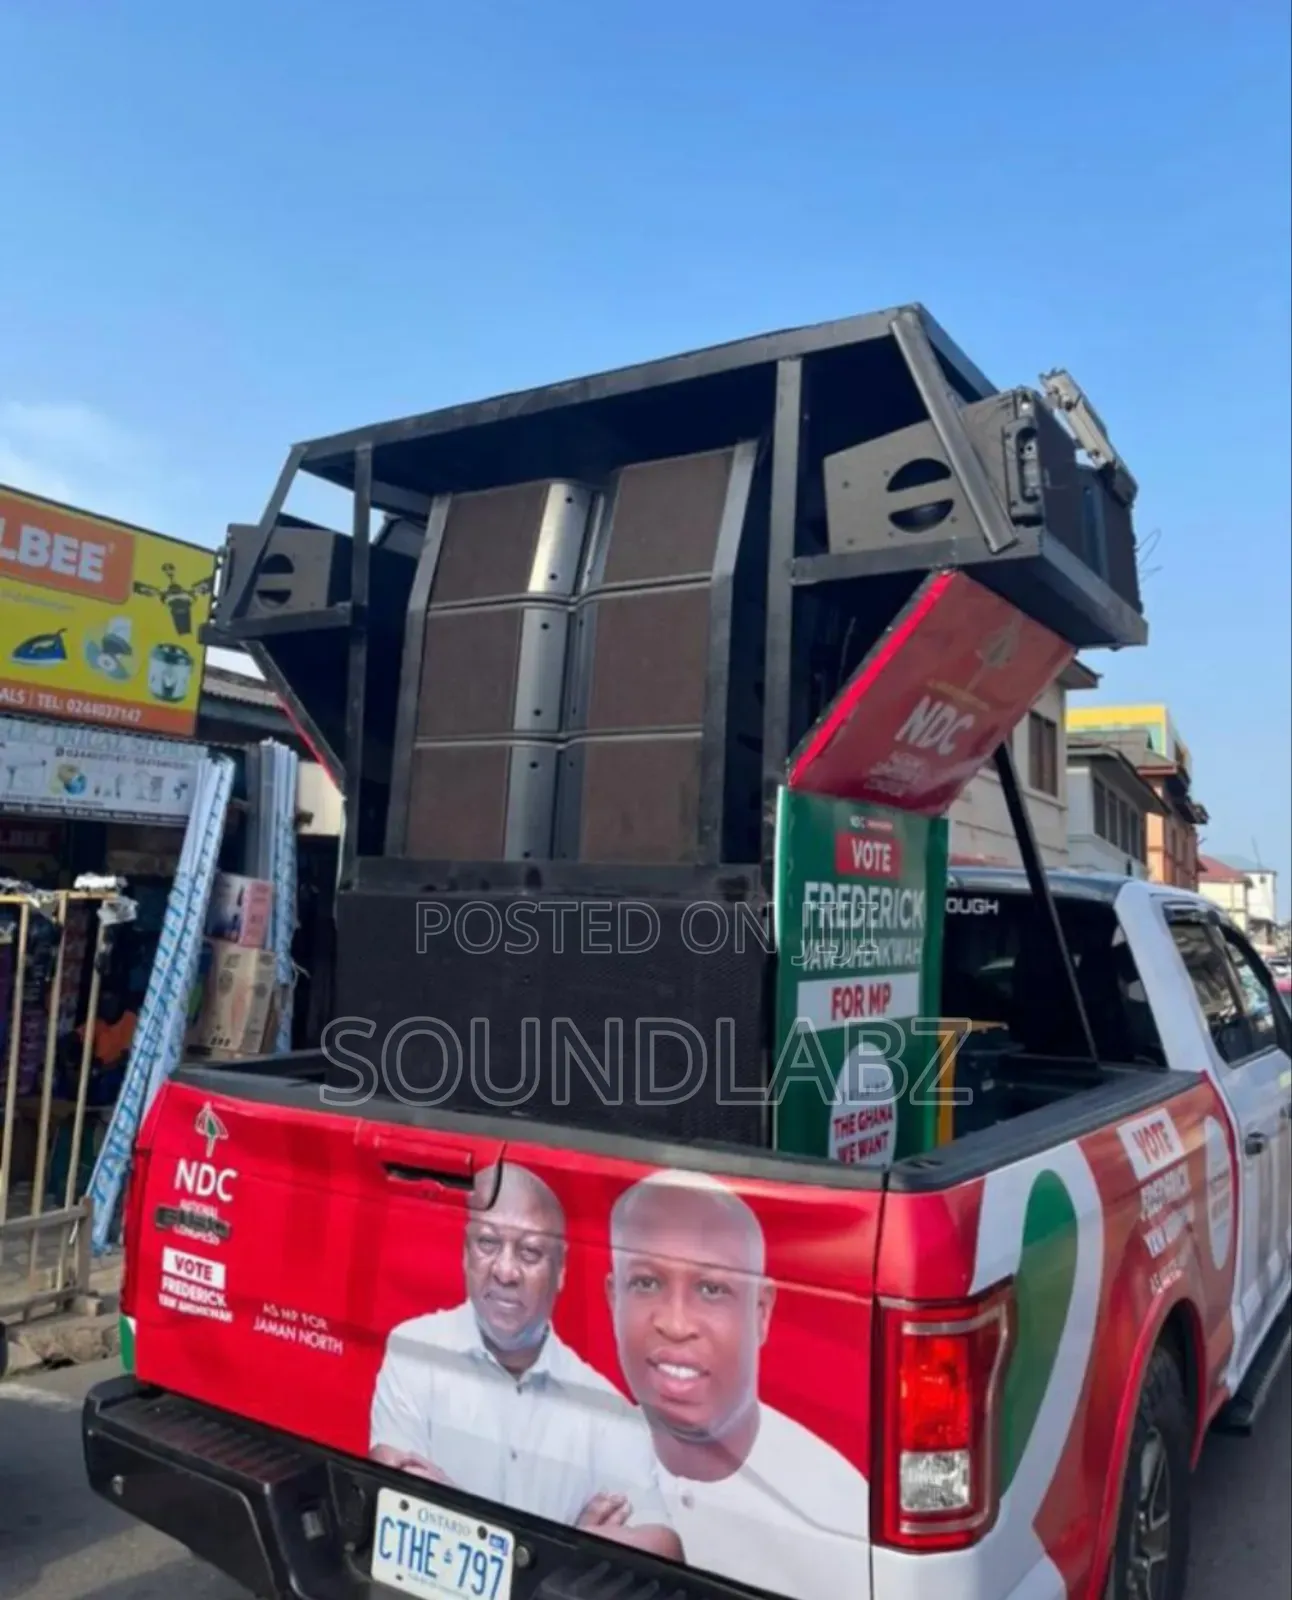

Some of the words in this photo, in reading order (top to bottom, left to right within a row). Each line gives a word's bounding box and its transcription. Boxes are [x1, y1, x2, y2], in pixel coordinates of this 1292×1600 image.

[894, 695, 975, 756] NDC
[852, 838, 892, 873] VOTE
[803, 881, 926, 930] FREDERICK
[831, 984, 864, 1021] FOR
[868, 982, 892, 1017] MP
[833, 1111, 857, 1140] THE
[857, 1130, 889, 1160] WANT
[1131, 1119, 1173, 1165] VOTE
[174, 1157, 238, 1203] NDC
[174, 1254, 213, 1282] VOTE
[161, 1274, 228, 1308] FREDERICK
[253, 1316, 296, 1342] JAMAN
[298, 1328, 344, 1356] NORTH
[418, 1507, 471, 1538] ONTARIO
[379, 1515, 441, 1578] CTHE
[457, 1541, 505, 1600] 797
